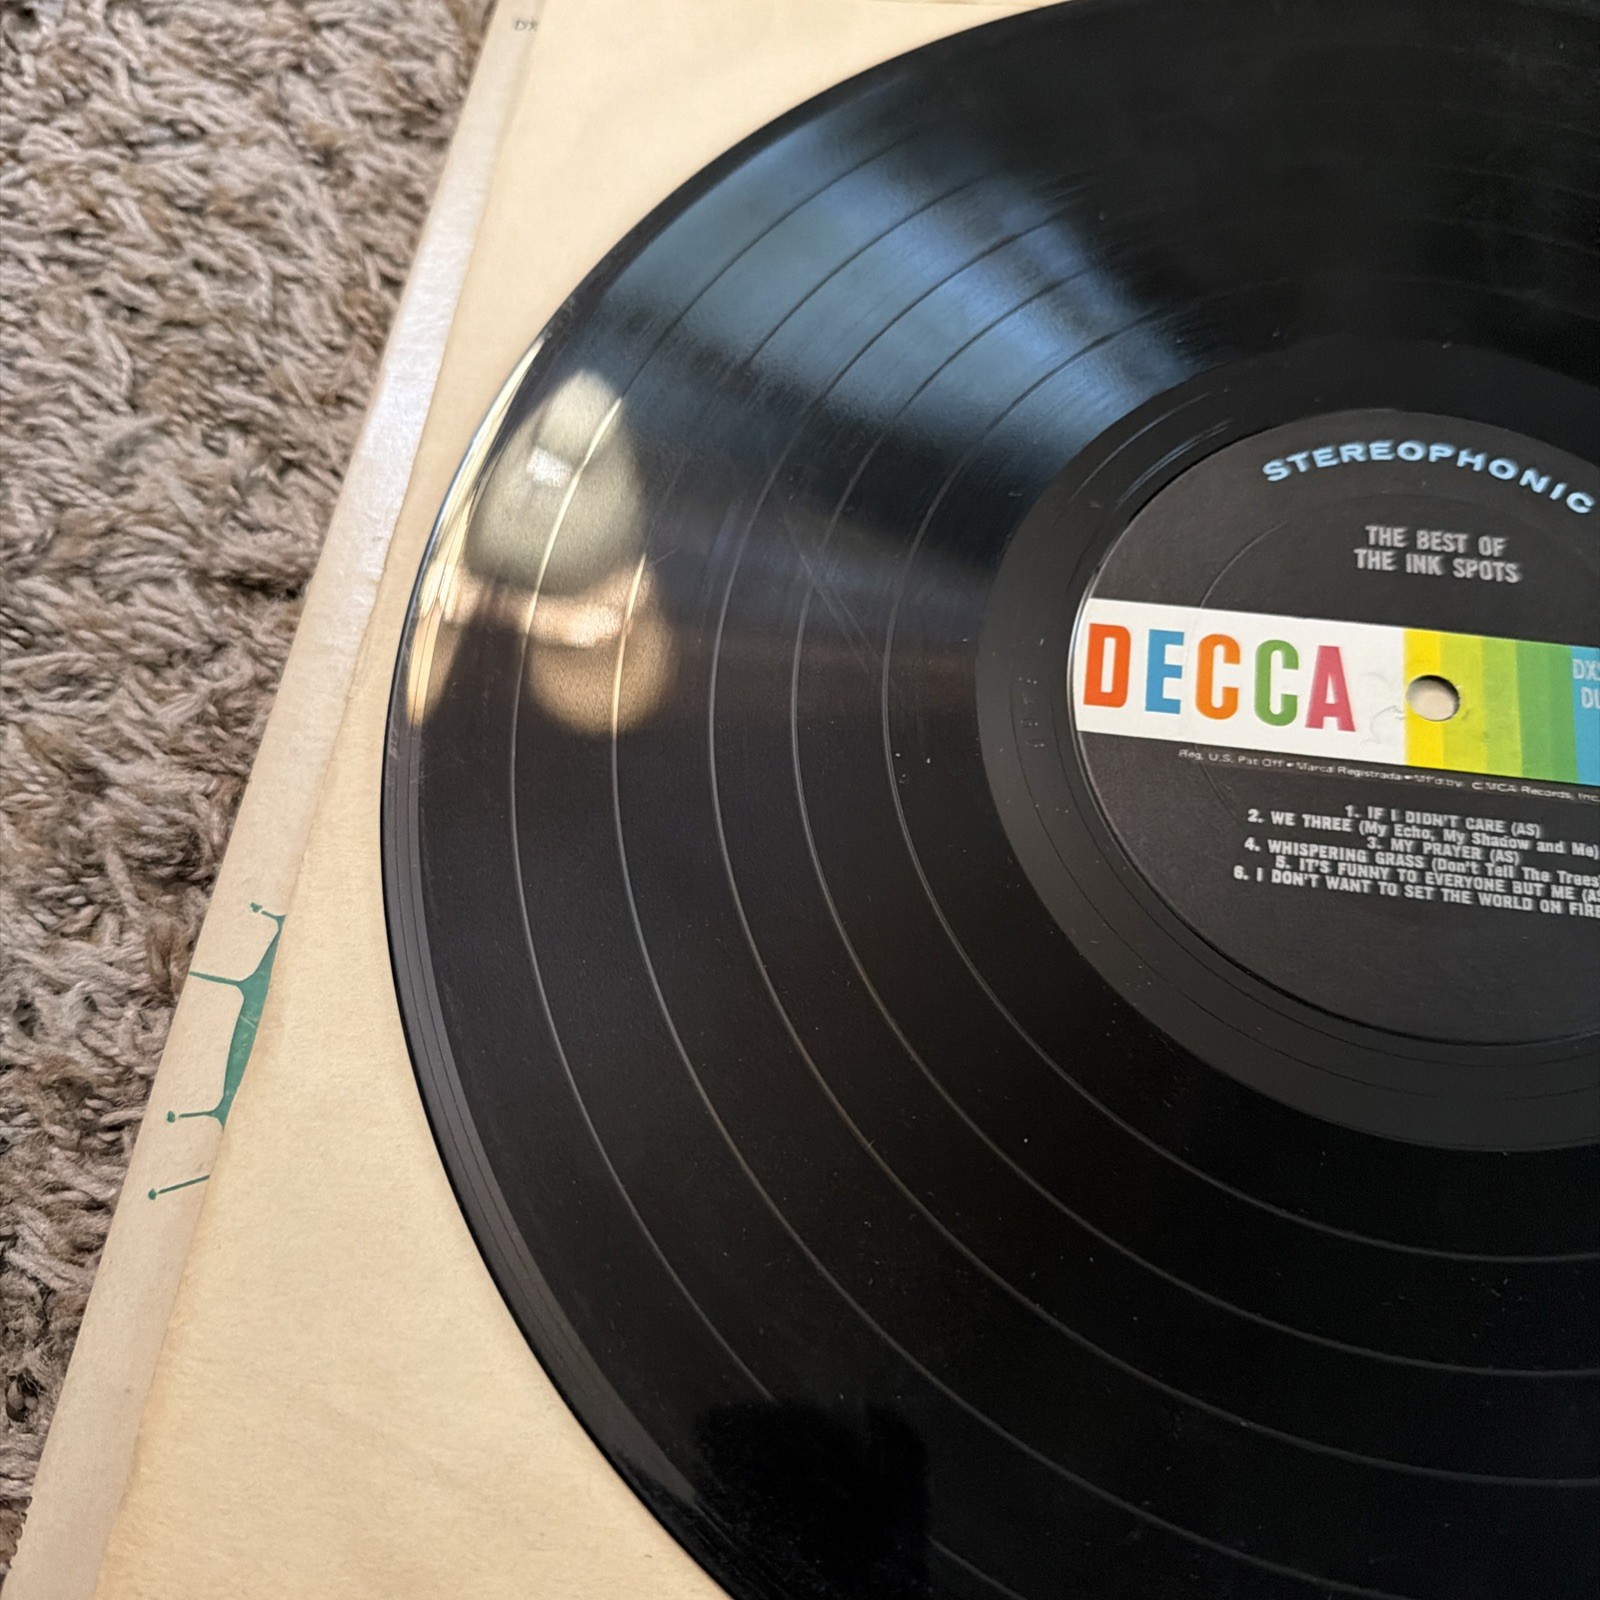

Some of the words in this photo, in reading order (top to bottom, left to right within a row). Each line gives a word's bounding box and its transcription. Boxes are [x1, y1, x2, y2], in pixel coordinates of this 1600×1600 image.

[1262, 439, 1597, 514] STEREOPHONIC
[1364, 525, 1408, 549] THE
[1416, 529, 1469, 554] BEST
[1478, 535, 1508, 558] OF
[1353, 548, 1398, 571] THE
[1405, 553, 1444, 576] INK
[1452, 557, 1523, 584] SPOTS
[1083, 622, 1356, 732] DECCA
[1247, 808, 1264, 823] 2.
[1270, 811, 1297, 826] WE
[1302, 813, 1353, 832] THREE
[1359, 819, 1389, 838] (My
[1394, 824, 1435, 842] Echo,
[1443, 828, 1467, 845] My
[1471, 832, 1532, 850] Shadow
[1536, 840, 1566, 854] and
[1571, 841, 1599, 860] Me)
[1344, 804, 1361, 819] 1.
[1367, 805, 1384, 820] IF
[1390, 808, 1399, 822] I
[1405, 810, 1460, 828] DIDN'T
[1465, 817, 1507, 834] CARE
[1510, 822, 1542, 839] (AS)
[1244, 836, 1261, 852] 4.
[1267, 839, 1368, 863] WHISPERING
[1374, 851, 1426, 869] GRASS
[1431, 857, 1481, 876] (Don't
[1484, 862, 1515, 879] Tell
[1521, 866, 1551, 882] The
[1366, 836, 1383, 850] 3.
[1390, 837, 1415, 853] MY
[1423, 842, 1485, 861] PRAYER
[1489, 849, 1520, 866] (AS)
[1233, 865, 1250, 881] 6.
[1256, 867, 1264, 882] I
[1271, 868, 1321, 888] DON'T
[1325, 875, 1375, 894] WANT
[1377, 881, 1400, 897] TO
[1404, 885, 1437, 901] SET
[1440, 888, 1475, 905] THE
[1478, 891, 1534, 911] WORLD
[1539, 899, 1565, 915] ON
[1275, 855, 1292, 869] 5.
[1299, 857, 1332, 874] IT'S
[1337, 862, 1393, 881] FUNNY
[1396, 868, 1419, 883] TO
[1425, 871, 1507, 893] EVERYONE
[1512, 880, 1545, 897] BUT
[1551, 884, 1576, 900] ME
